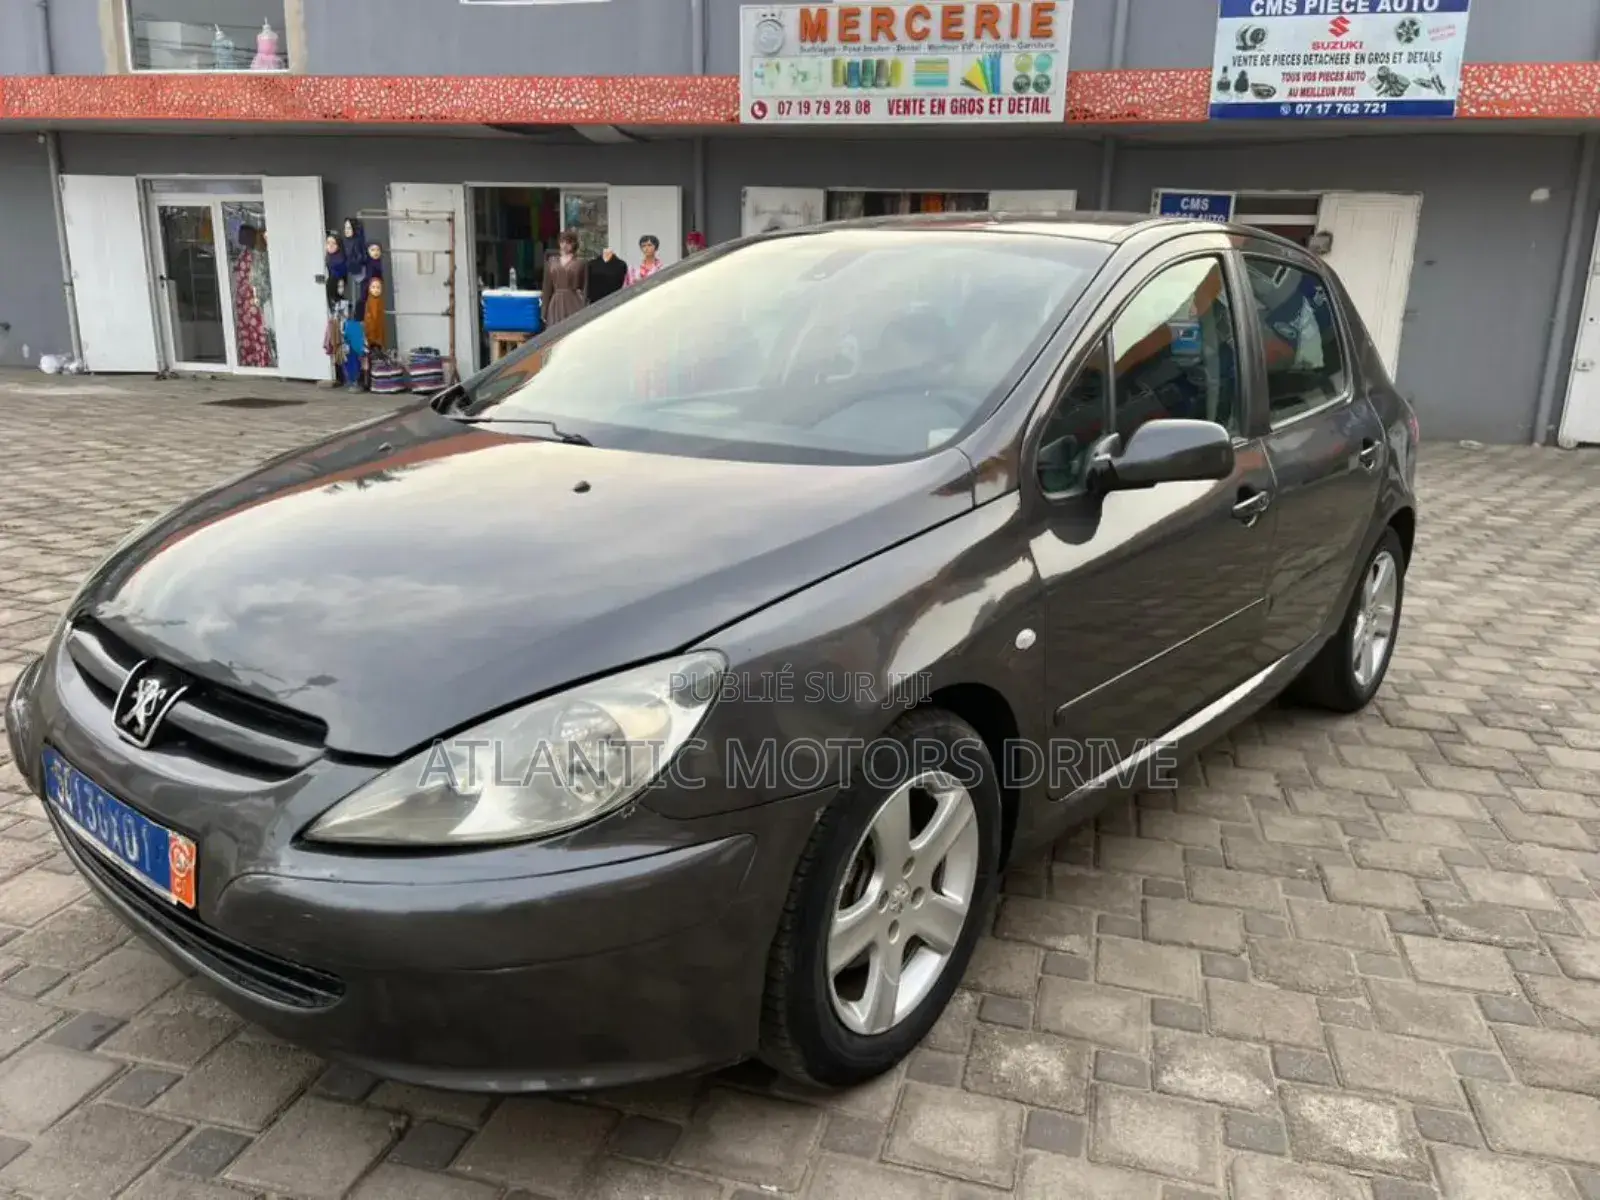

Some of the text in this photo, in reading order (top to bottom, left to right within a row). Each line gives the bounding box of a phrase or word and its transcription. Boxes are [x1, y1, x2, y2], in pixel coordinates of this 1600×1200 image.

[1250, 0, 1297, 16] CMS
[1376, 0, 1438, 13] AUTO
[799, 3, 1056, 42] MERCERIE
[1311, 41, 1364, 50] SUZUKI
[1232, 51, 1442, 67] VENTE DE PIECES DETACHEES EN GROS ET DETAILS
[1281, 70, 1366, 82] TOUS VOS PIECES AUTO
[1288, 86, 1355, 97] AU MEILLEUR PRIX
[778, 100, 792, 115] 07
[797, 100, 811, 115] 19
[816, 100, 831, 115] 79
[835, 100, 850, 115] 28
[888, 96, 1052, 115] VENTE EN GROS ET DETAIL
[1295, 102, 1387, 114] 07 17 762 721
[1180, 196, 1209, 211] CMS
